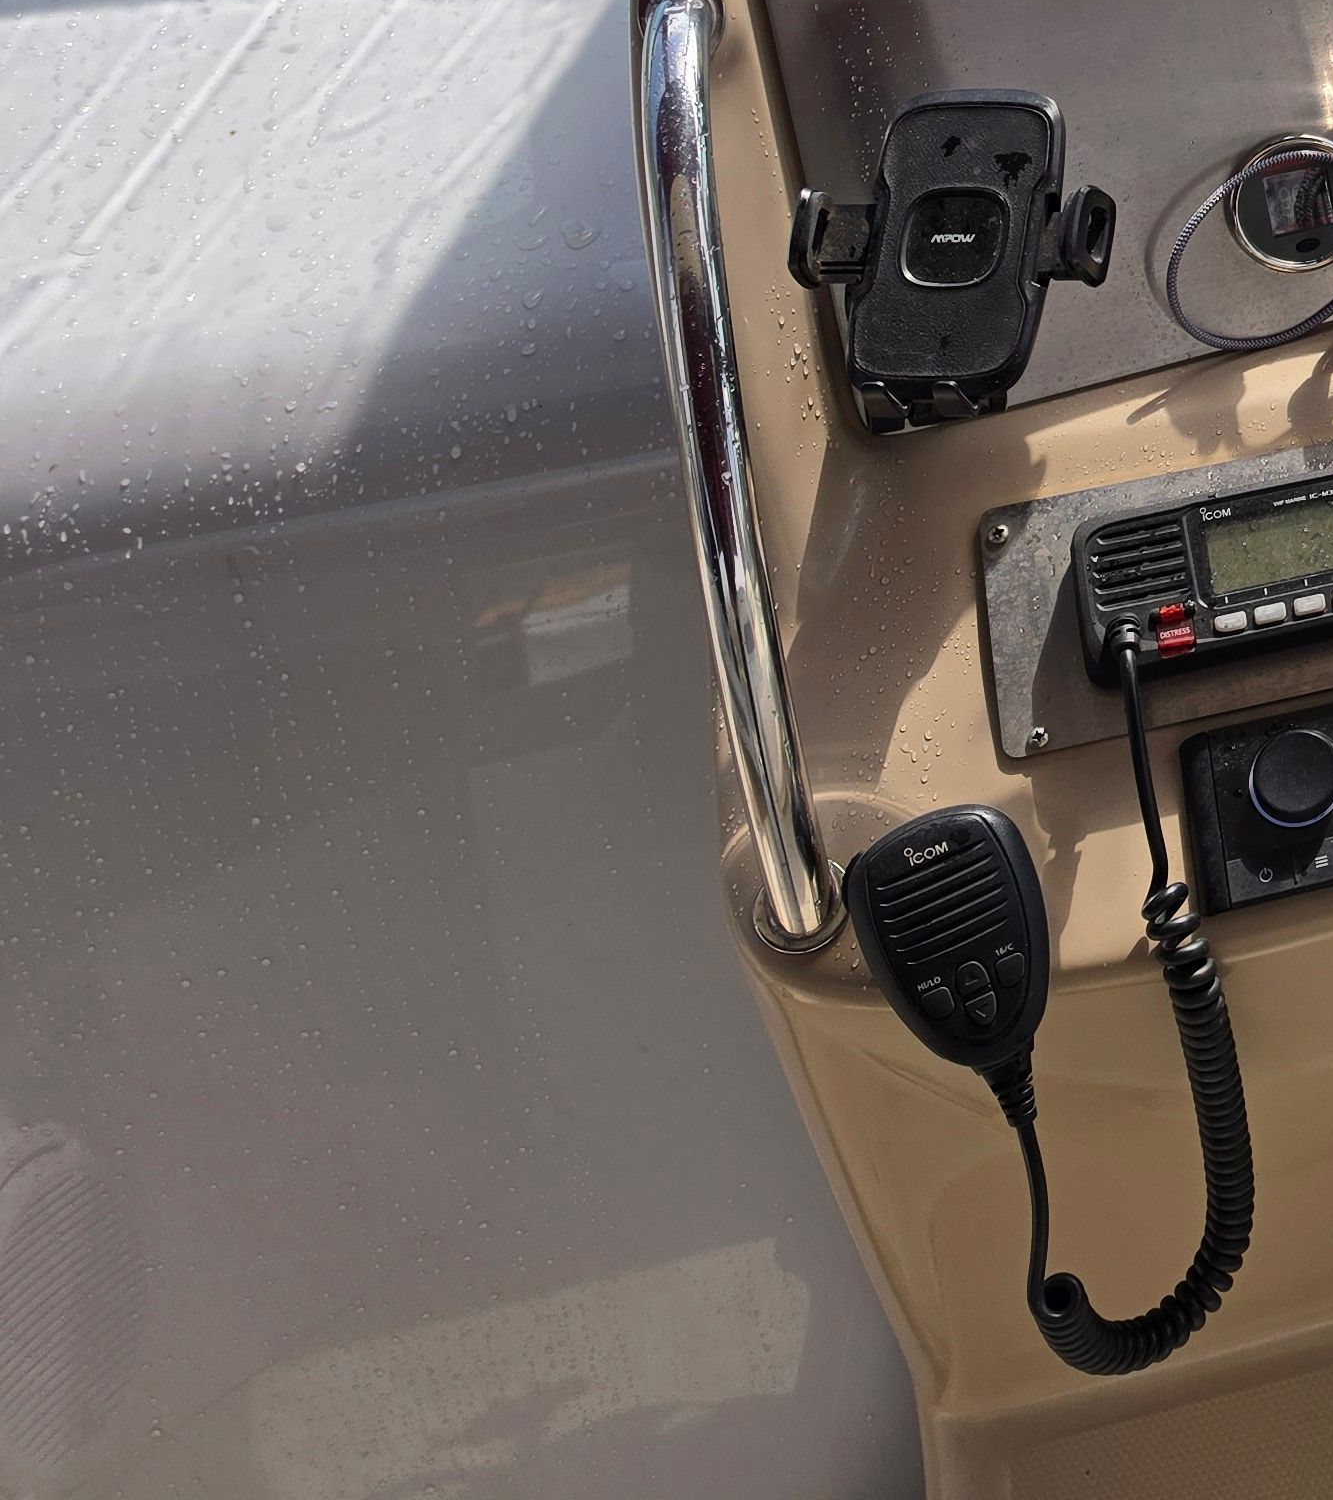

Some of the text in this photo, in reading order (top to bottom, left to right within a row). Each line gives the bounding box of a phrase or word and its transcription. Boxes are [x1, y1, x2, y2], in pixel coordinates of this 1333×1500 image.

[931, 234, 976, 243] MPOW
[1159, 625, 1192, 641] DISTRESS
[995, 943, 1014, 956] 16/C
[917, 976, 941, 991] HI/LO
